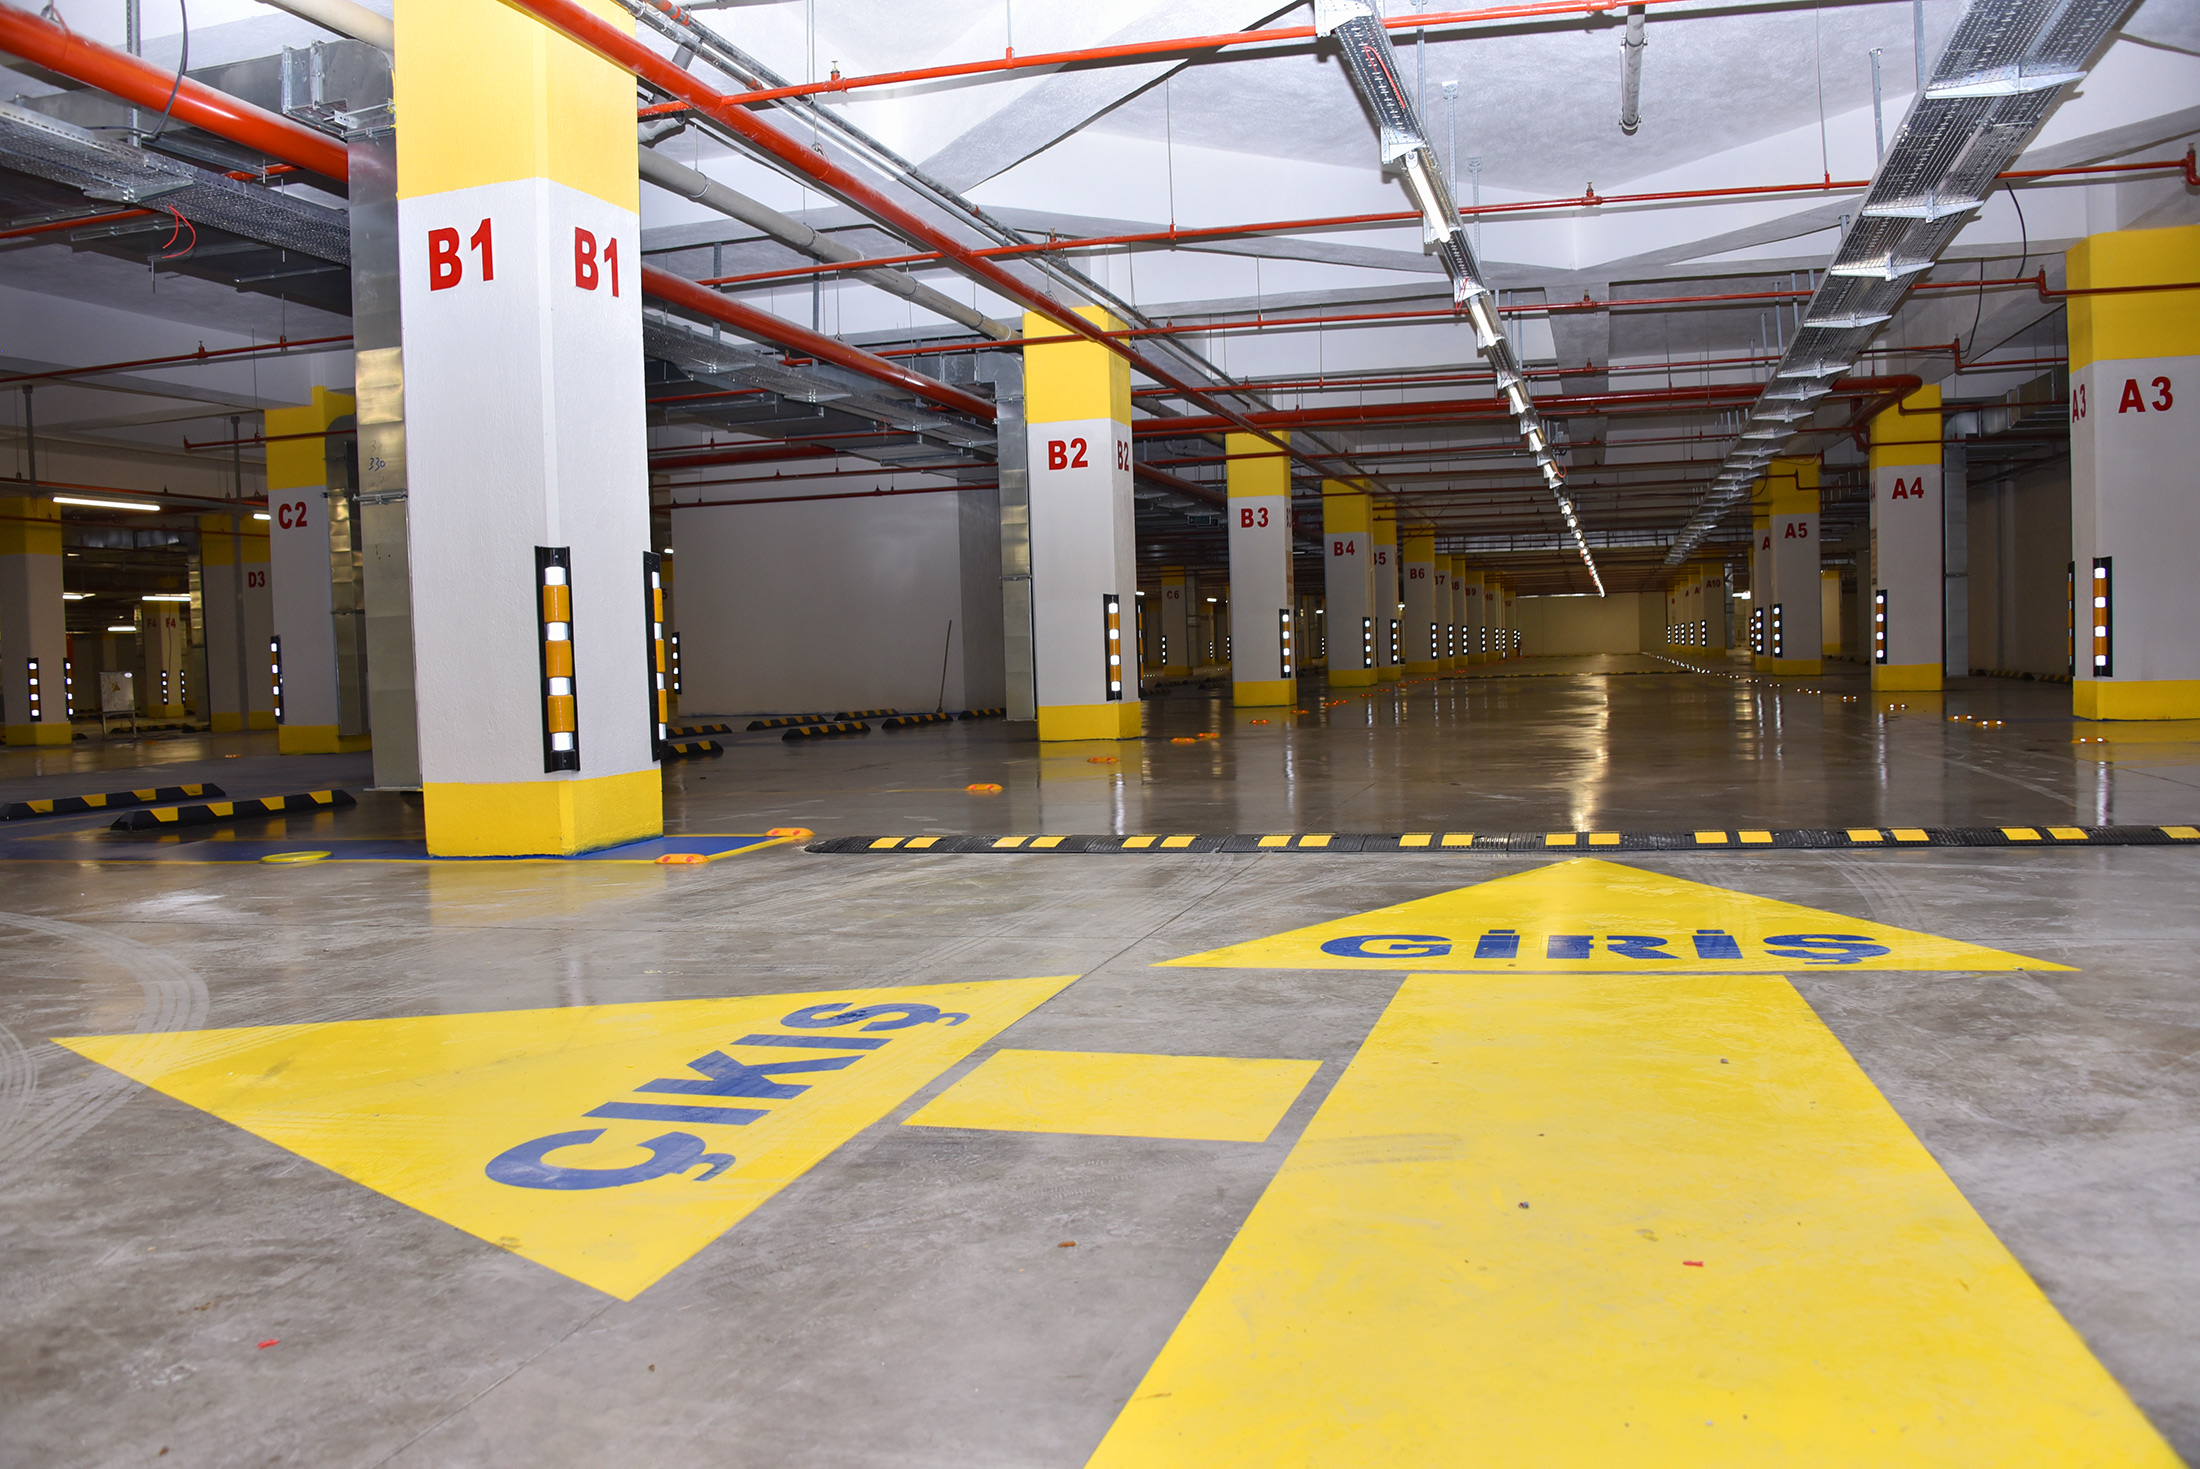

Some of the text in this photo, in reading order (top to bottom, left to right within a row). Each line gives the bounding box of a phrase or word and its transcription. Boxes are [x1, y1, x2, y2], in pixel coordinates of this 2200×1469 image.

[428, 218, 494, 292] B1
[575, 226, 620, 298] B1
[2072, 384, 2087, 424] A3
[2118, 376, 2174, 414] A3
[1047, 437, 1089, 471] B2
[1117, 439, 1130, 472] B2
[1891, 476, 1925, 500] A4
[278, 501, 308, 530] C2
[1240, 507, 1269, 529] B3
[1784, 522, 1808, 539] A5
[1333, 540, 1356, 557] B4
[248, 571, 266, 589] D3
[1409, 568, 1425, 580] B6
[1706, 579, 1721, 588] A10
[1166, 590, 1180, 600] C6
[1320, 929, 1892, 966] GİRİŞ
[485, 1002, 971, 1191] ÇIKIŞ
